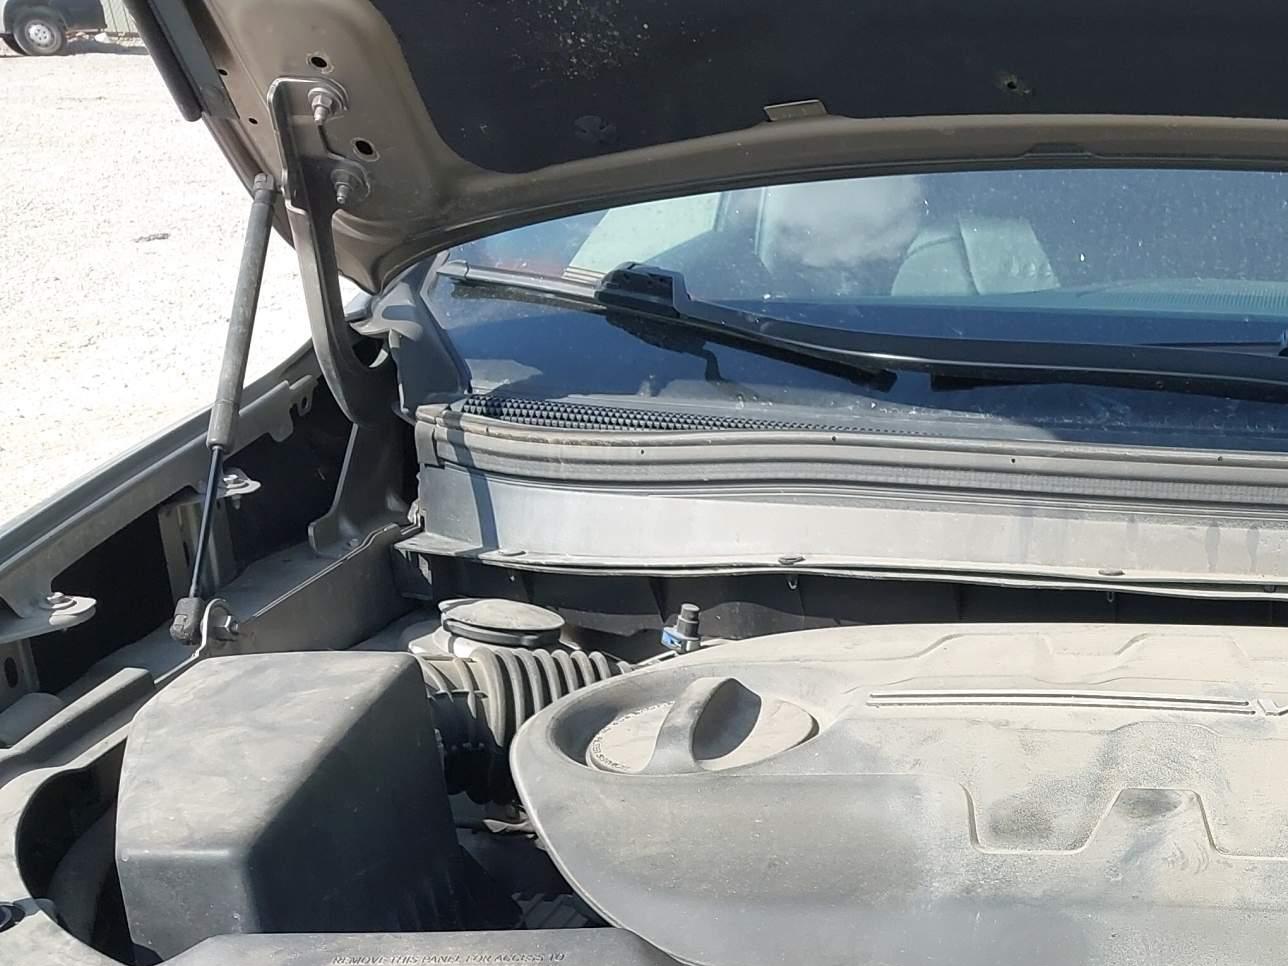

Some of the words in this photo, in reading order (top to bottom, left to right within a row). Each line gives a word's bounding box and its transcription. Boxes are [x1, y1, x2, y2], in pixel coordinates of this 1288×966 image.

[332, 956, 386, 965] REMOVE
[390, 956, 418, 964] THIS
[421, 955, 460, 964] PANEL
[465, 955, 492, 963] FOR
[494, 954, 545, 963] ACCESS
[549, 953, 565, 961] TO
